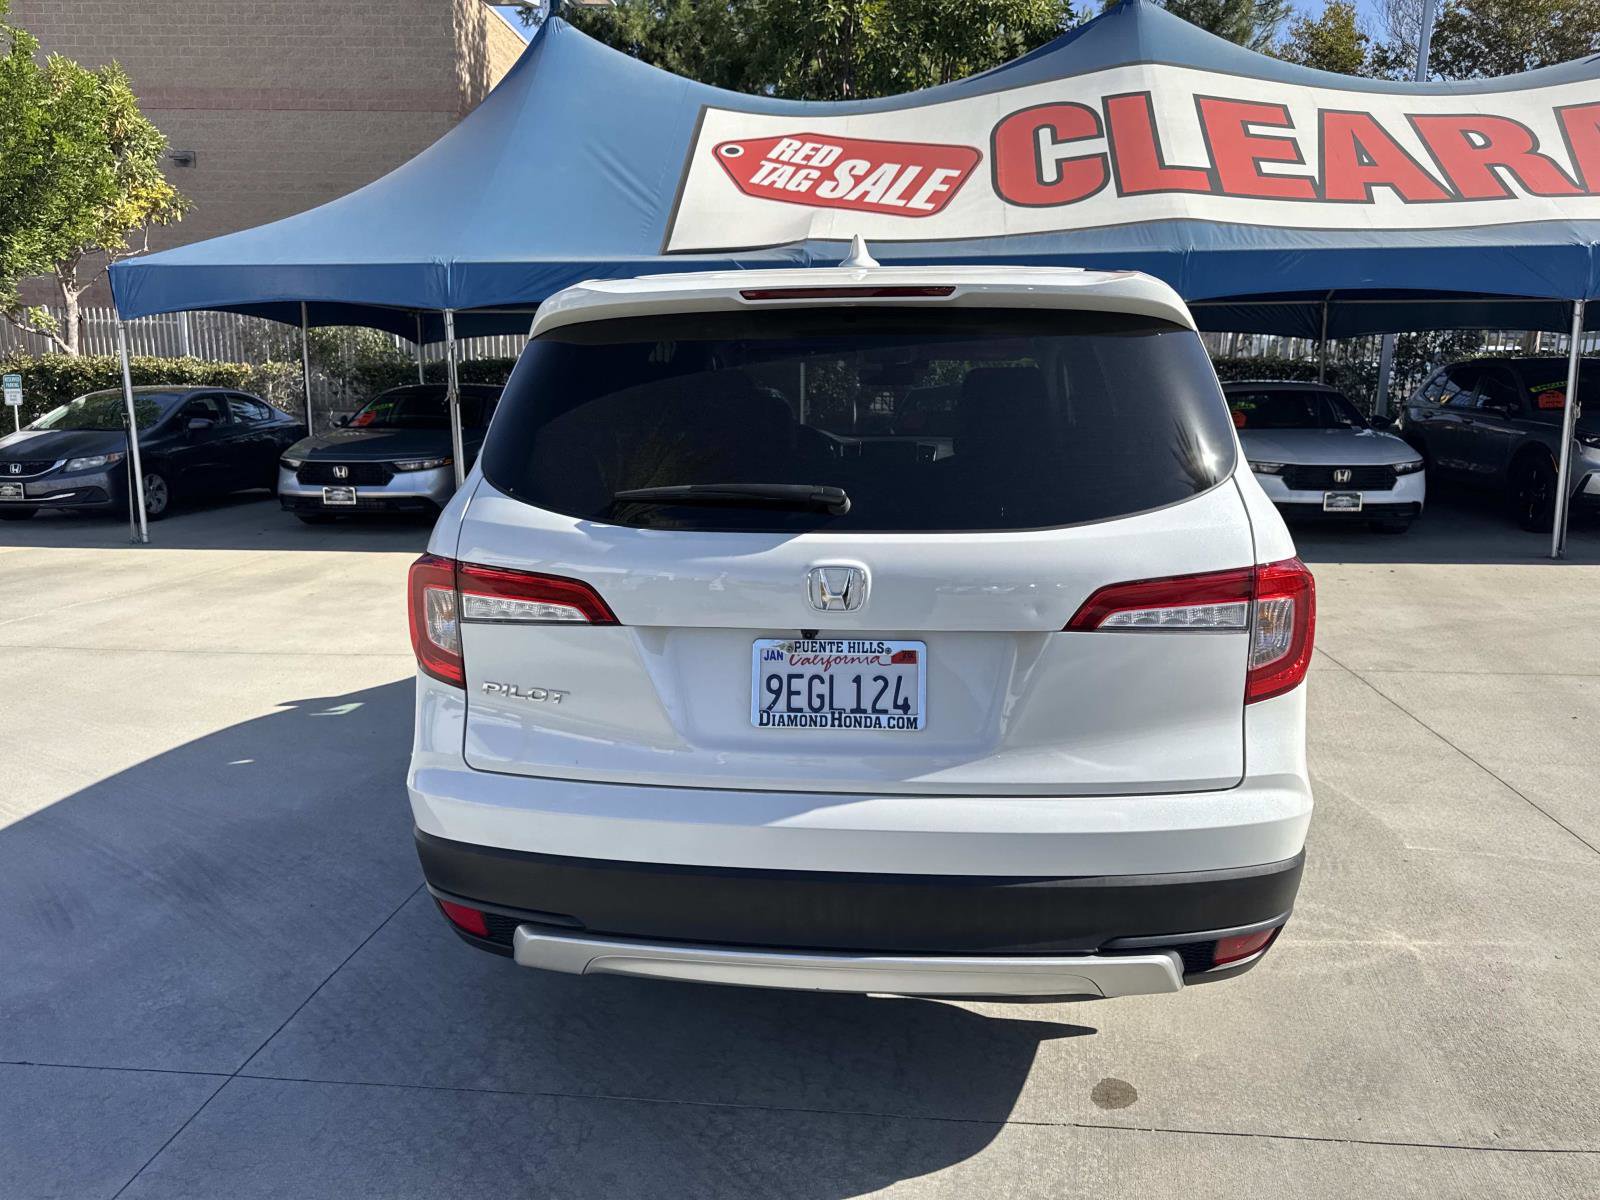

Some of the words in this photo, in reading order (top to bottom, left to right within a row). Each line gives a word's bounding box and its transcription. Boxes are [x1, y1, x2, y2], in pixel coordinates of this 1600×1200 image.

[767, 138, 844, 168] RED
[749, 160, 821, 192] TAG
[815, 159, 962, 211] SALE
[763, 650, 784, 661] JAN
[795, 641, 843, 653] PUENTE
[848, 641, 885, 654] HILLS
[789, 653, 892, 672] California
[481, 681, 570, 704] PILOT
[766, 674, 911, 714] 9EGL124
